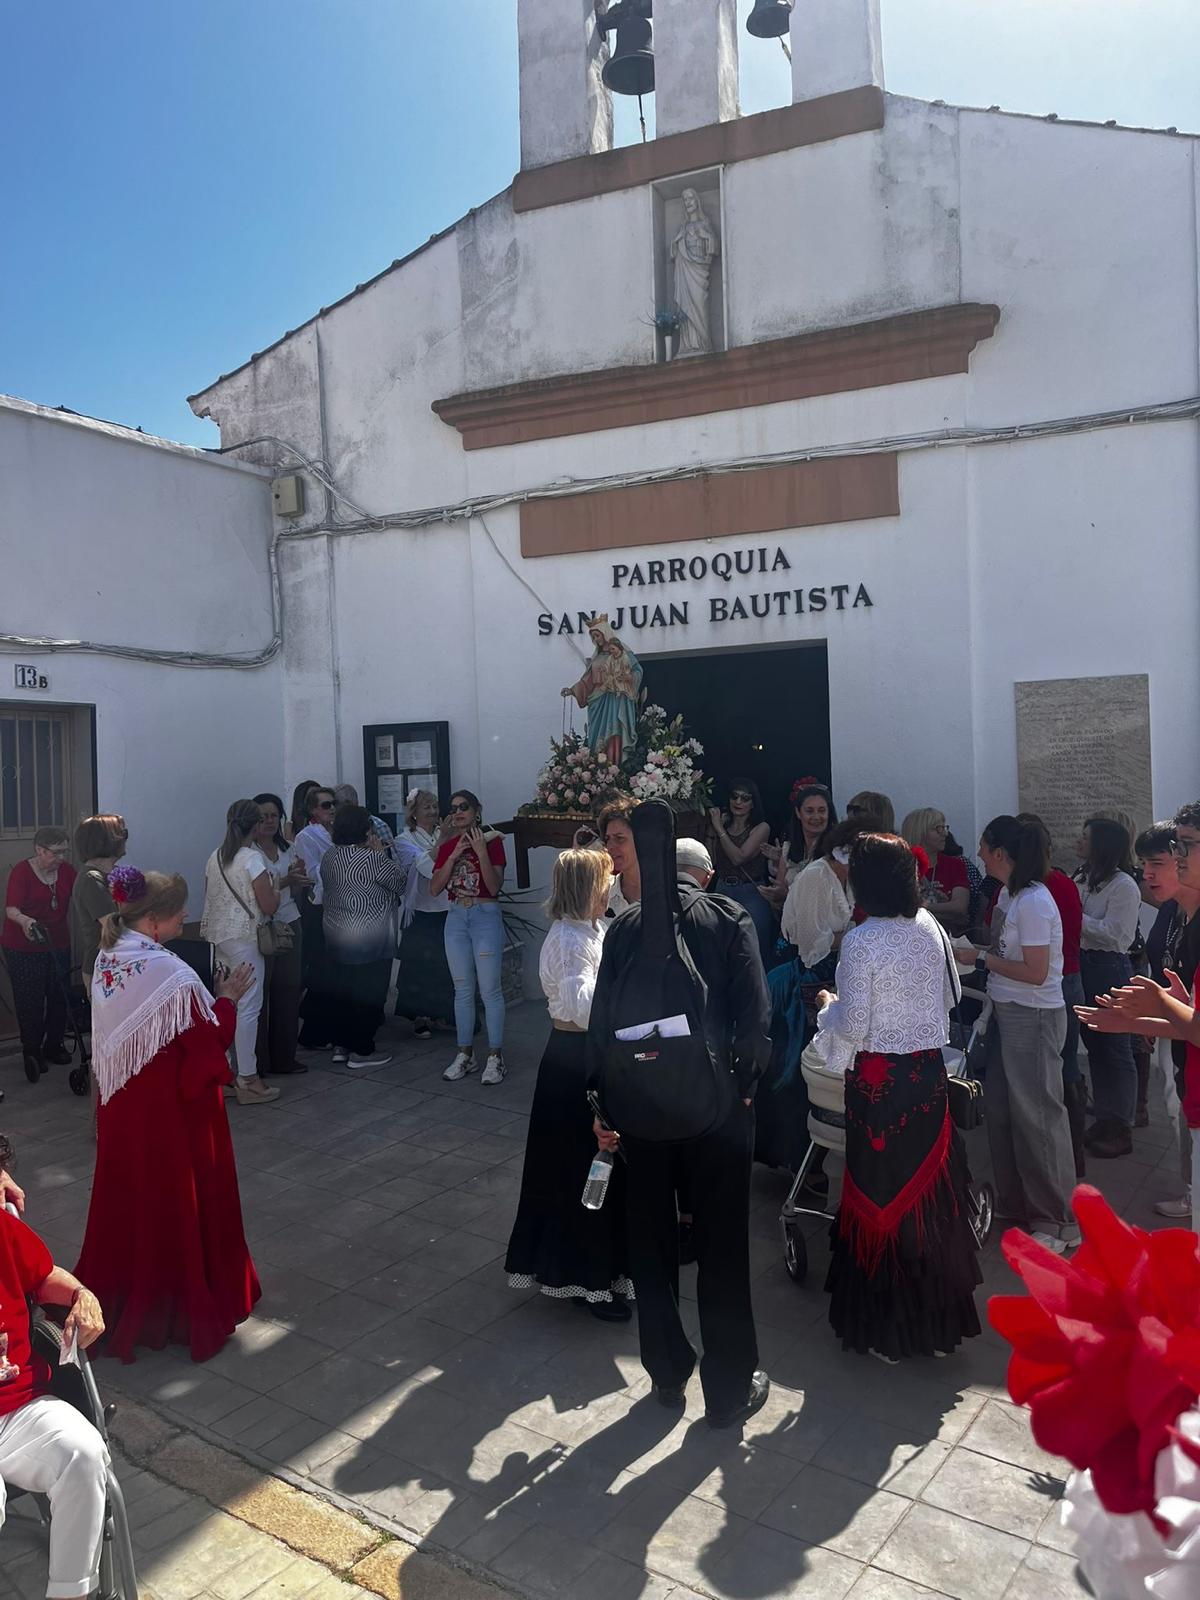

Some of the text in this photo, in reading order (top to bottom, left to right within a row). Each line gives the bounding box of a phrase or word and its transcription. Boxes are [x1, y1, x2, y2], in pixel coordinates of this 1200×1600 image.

[611, 547, 791, 588] PARROQUIA
[611, 601, 689, 631] JUAN
[709, 583, 874, 623] BAUTISTA
